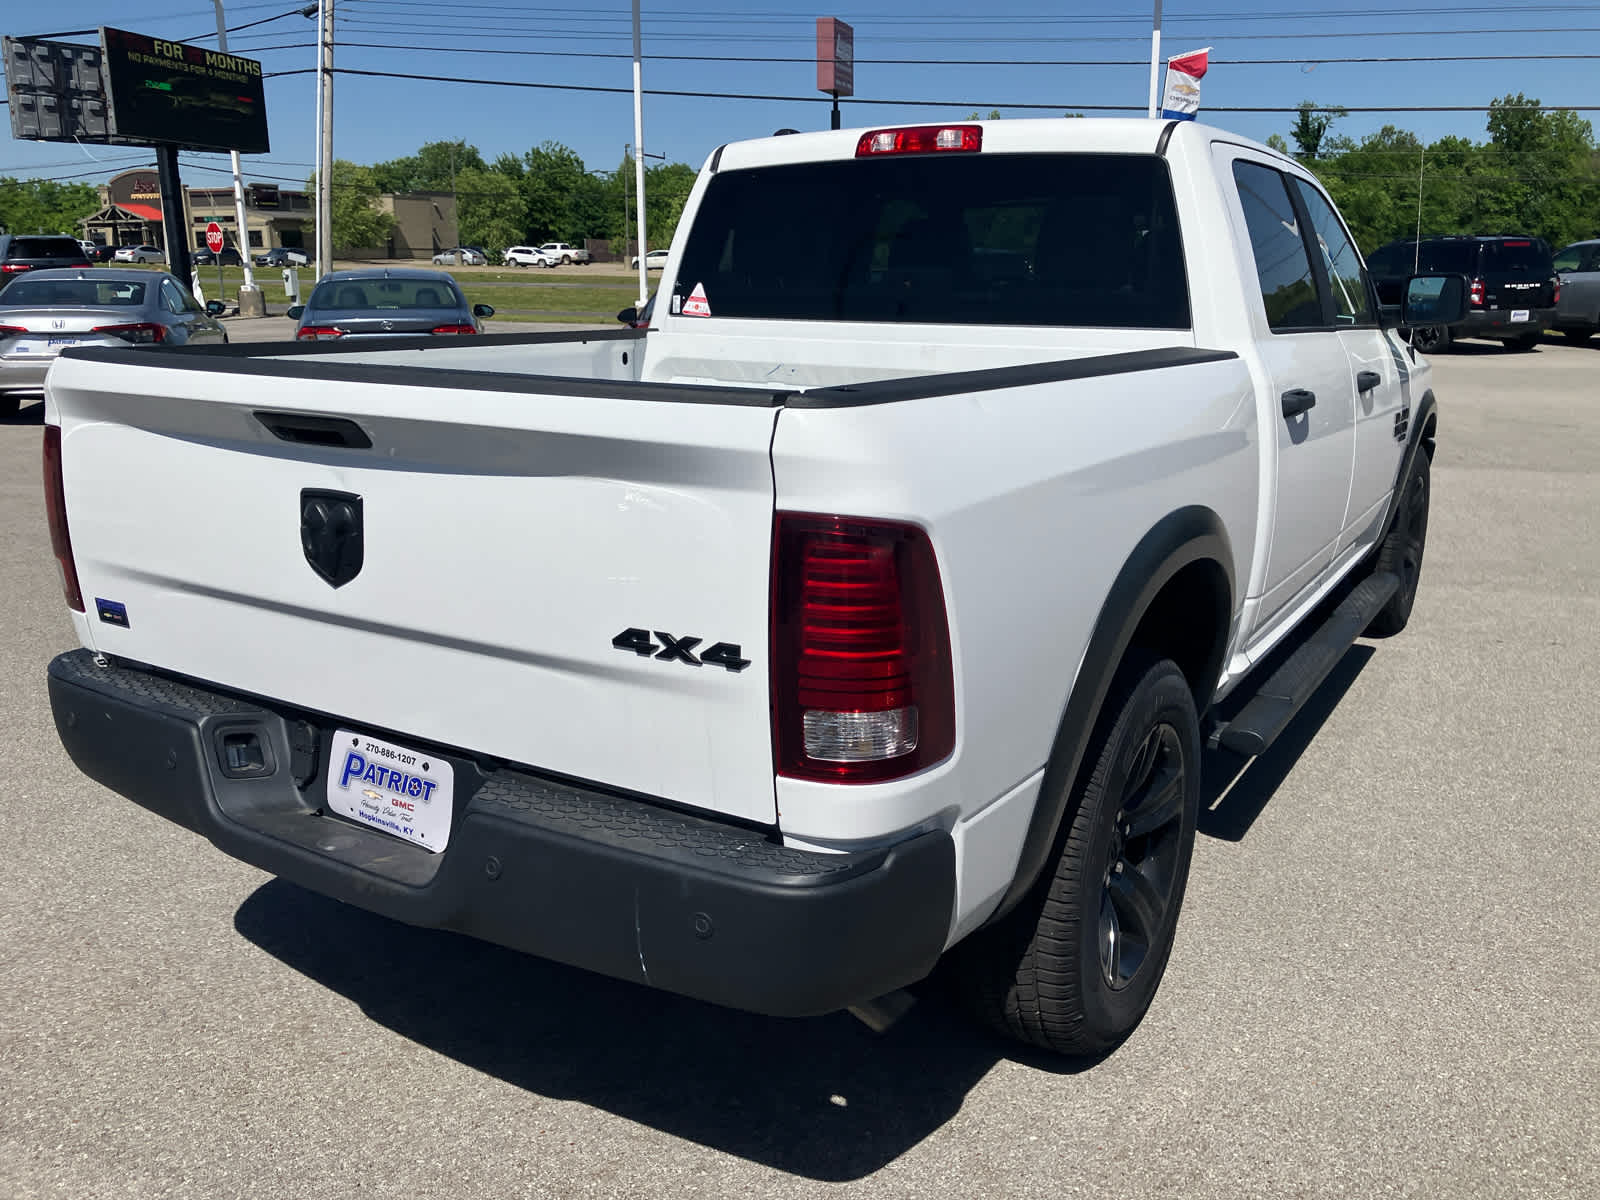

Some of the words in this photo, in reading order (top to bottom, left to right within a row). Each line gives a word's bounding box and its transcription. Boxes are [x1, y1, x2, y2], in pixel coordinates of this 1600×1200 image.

[144, 54, 189, 72] PAYMENTS
[154, 40, 184, 60] FOR
[205, 51, 261, 76] MONTHS
[207, 231, 222, 244] STOP
[366, 743, 416, 766] 270-886-1207
[341, 752, 436, 801] PATRIOT
[391, 798, 415, 812] GMC
[403, 826, 414, 836] KY
